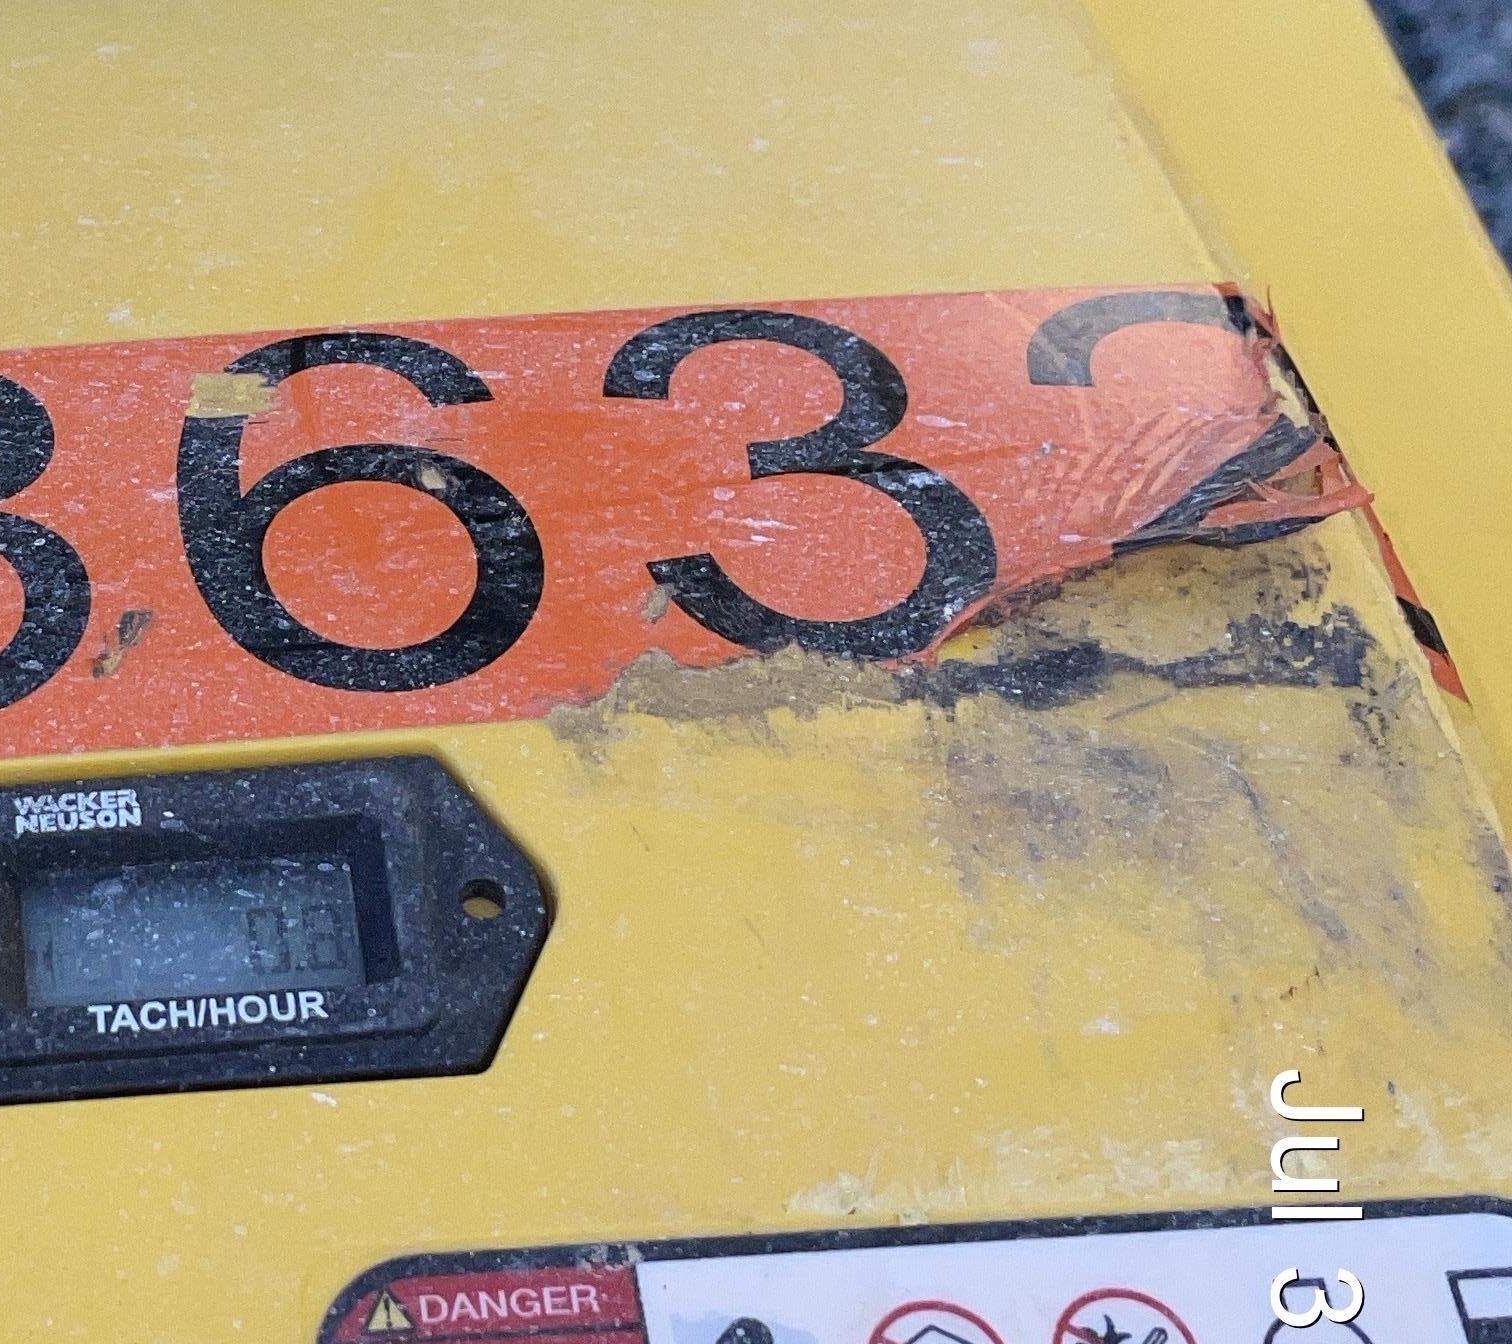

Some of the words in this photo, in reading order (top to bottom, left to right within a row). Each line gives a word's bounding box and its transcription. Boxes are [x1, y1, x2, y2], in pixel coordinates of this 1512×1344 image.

[14, 788, 140, 815] WACKER
[15, 808, 142, 837] NEUSON
[89, 990, 329, 1034] TACH/HOUR
[418, 1285, 600, 1326] DANGER
